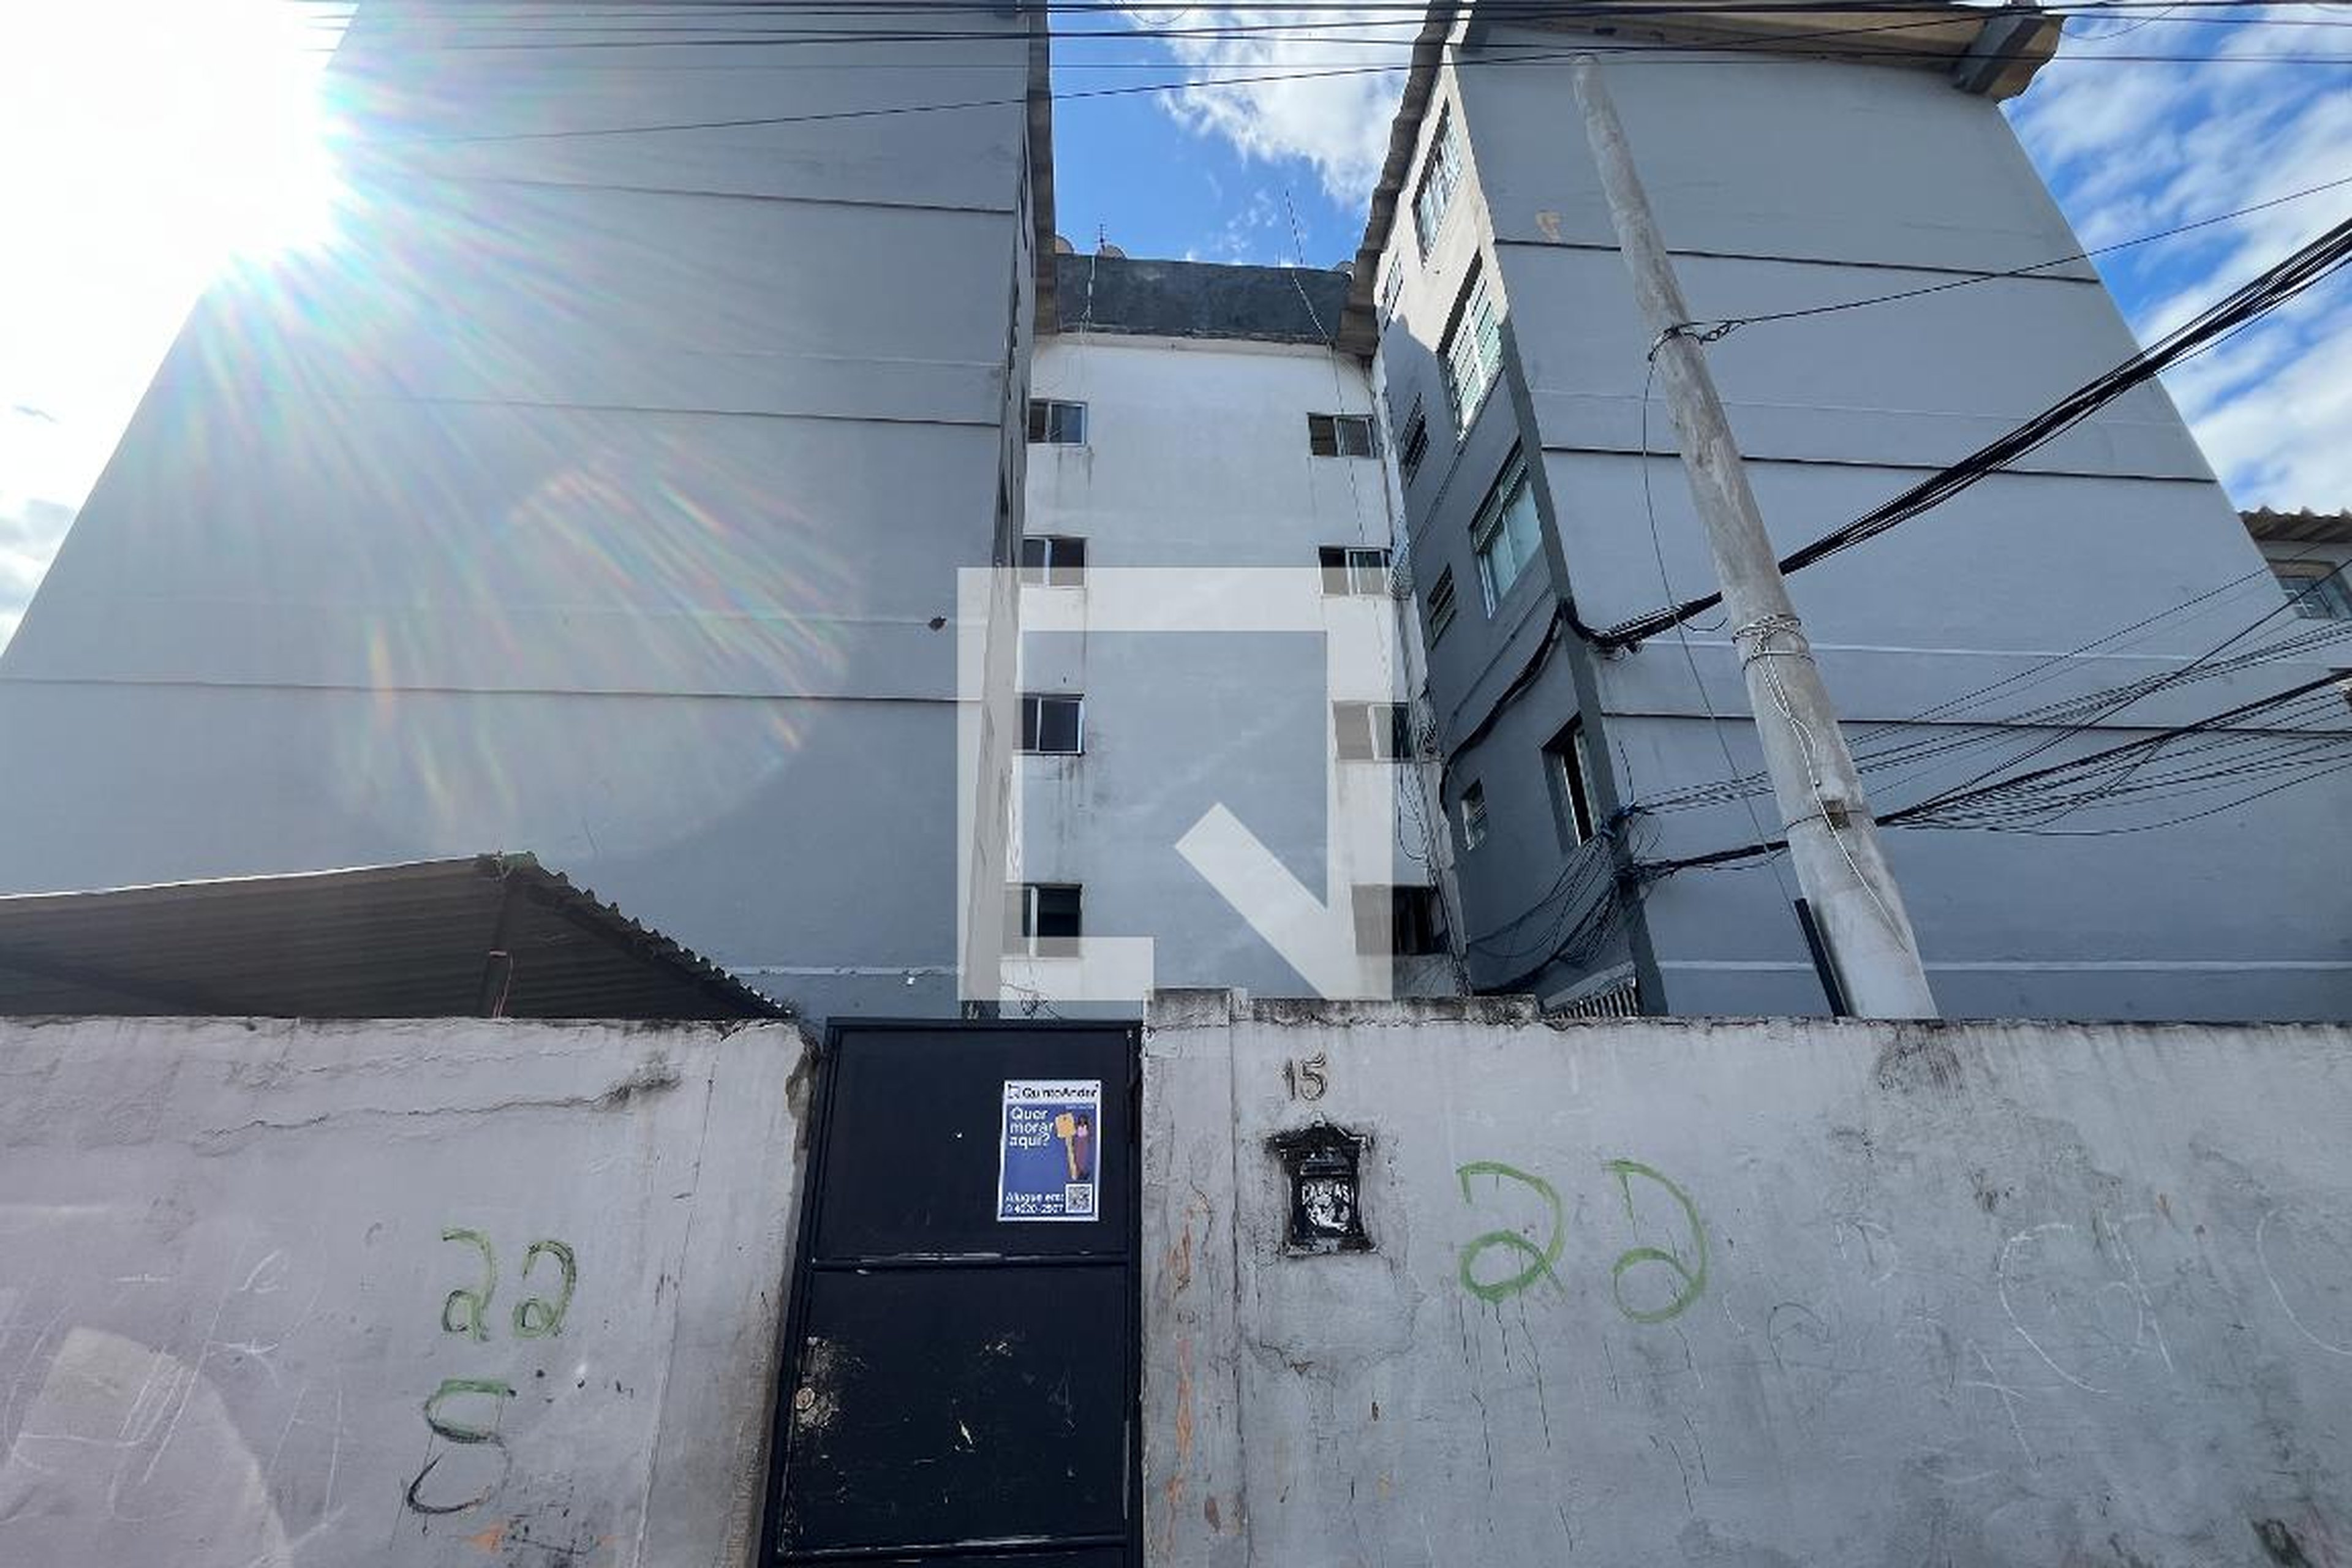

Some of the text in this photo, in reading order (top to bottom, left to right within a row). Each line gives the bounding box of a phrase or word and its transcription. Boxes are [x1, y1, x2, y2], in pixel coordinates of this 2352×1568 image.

[1283, 1052, 1327, 1101] 15
[1011, 1106, 1048, 1120] Quer
[1010, 1123, 1054, 1133] morar
[1009, 1134, 1050, 1150] aqui?
